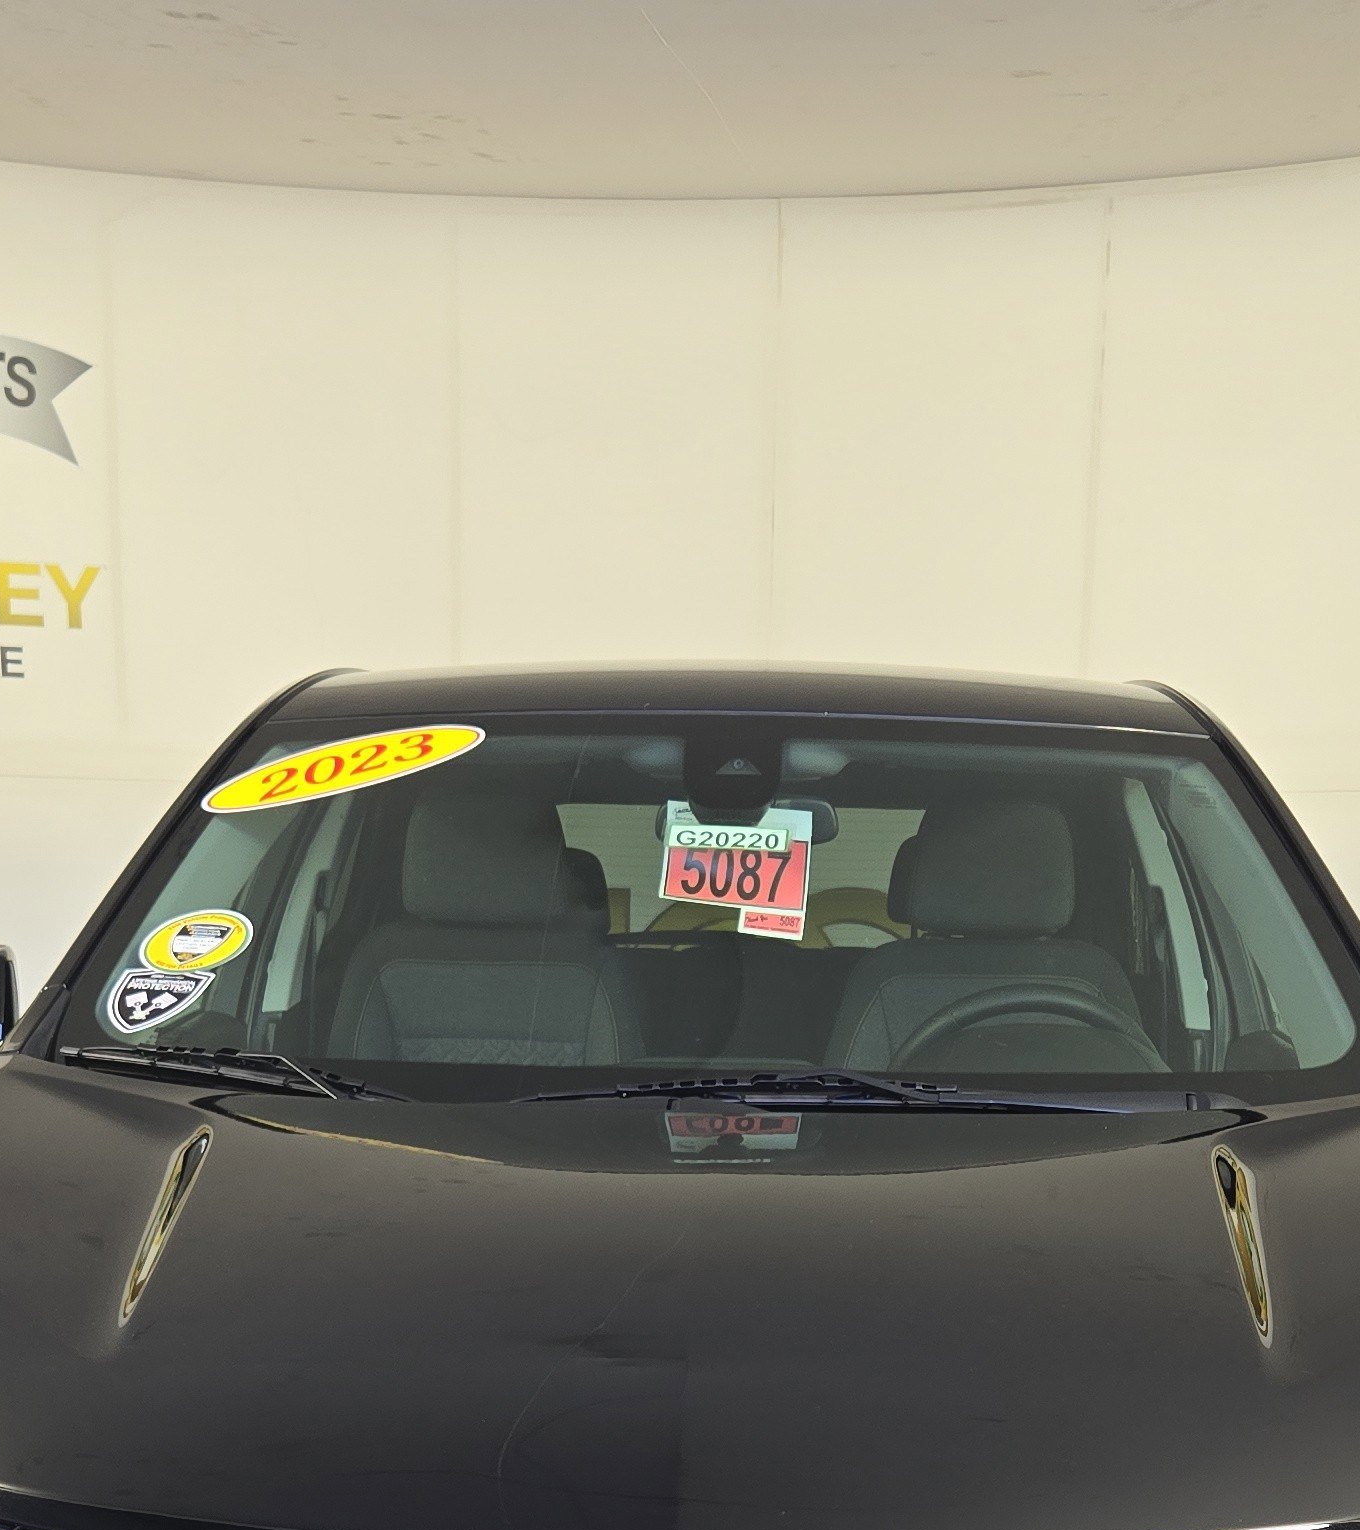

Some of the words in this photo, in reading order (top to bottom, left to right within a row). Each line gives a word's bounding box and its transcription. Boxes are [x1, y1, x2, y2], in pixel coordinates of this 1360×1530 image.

[259, 733, 434, 802] 2023
[676, 830, 779, 849] G20220
[681, 850, 792, 903] 5087
